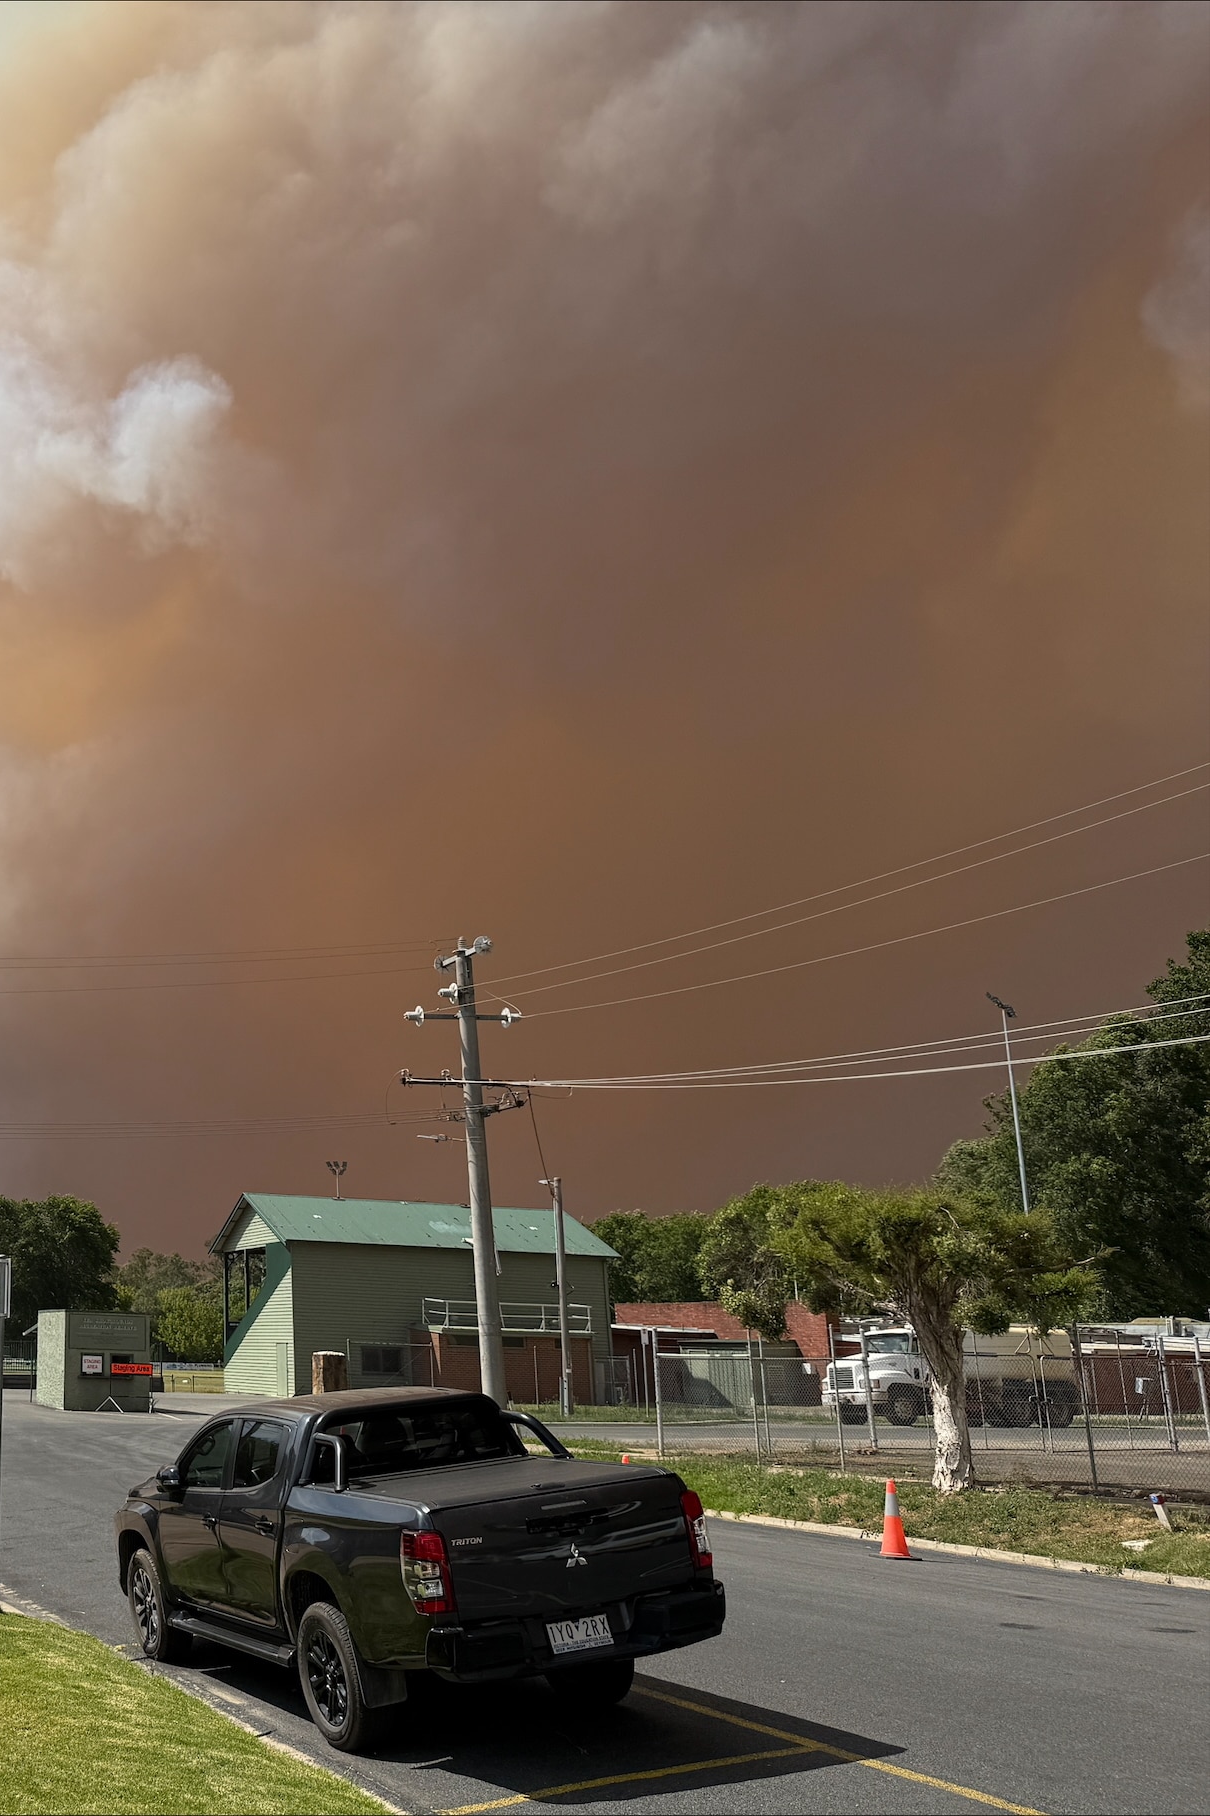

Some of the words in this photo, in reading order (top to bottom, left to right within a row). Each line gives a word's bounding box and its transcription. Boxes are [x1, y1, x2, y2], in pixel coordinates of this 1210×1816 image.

[113, 1364, 135, 1372] Staging
[451, 1536, 483, 1546] TRITON
[582, 1617, 609, 1637] 2RX
